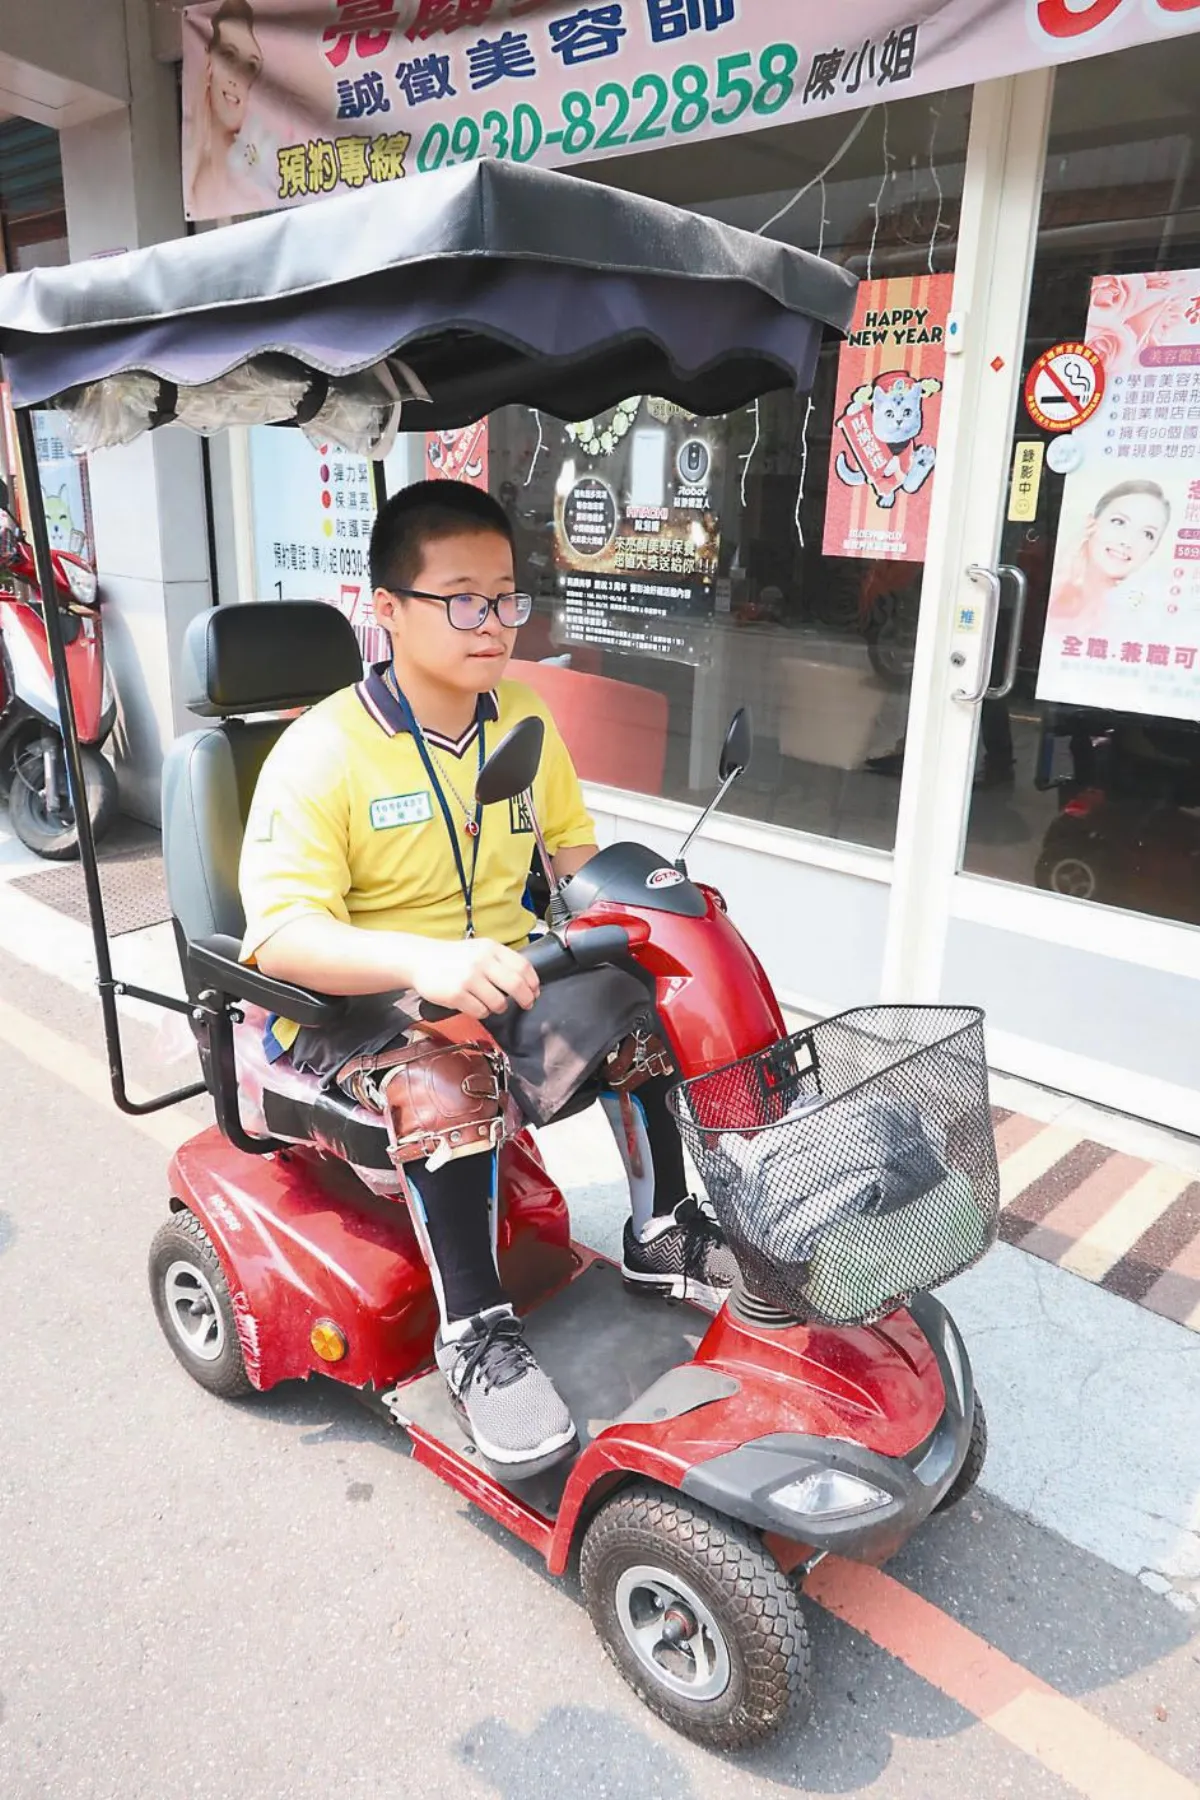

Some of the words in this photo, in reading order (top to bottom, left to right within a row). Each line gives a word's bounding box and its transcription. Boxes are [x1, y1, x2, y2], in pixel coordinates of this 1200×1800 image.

[336, 0, 735, 119] 誠徵美容師
[277, 130, 412, 199] 預約專線
[416, 43, 798, 174] 0930-822858
[802, 24, 918, 104] 陳小姐
[848, 328, 888, 348] NEW
[893, 326, 943, 345] YEAR
[866, 309, 929, 328] HAPPY
